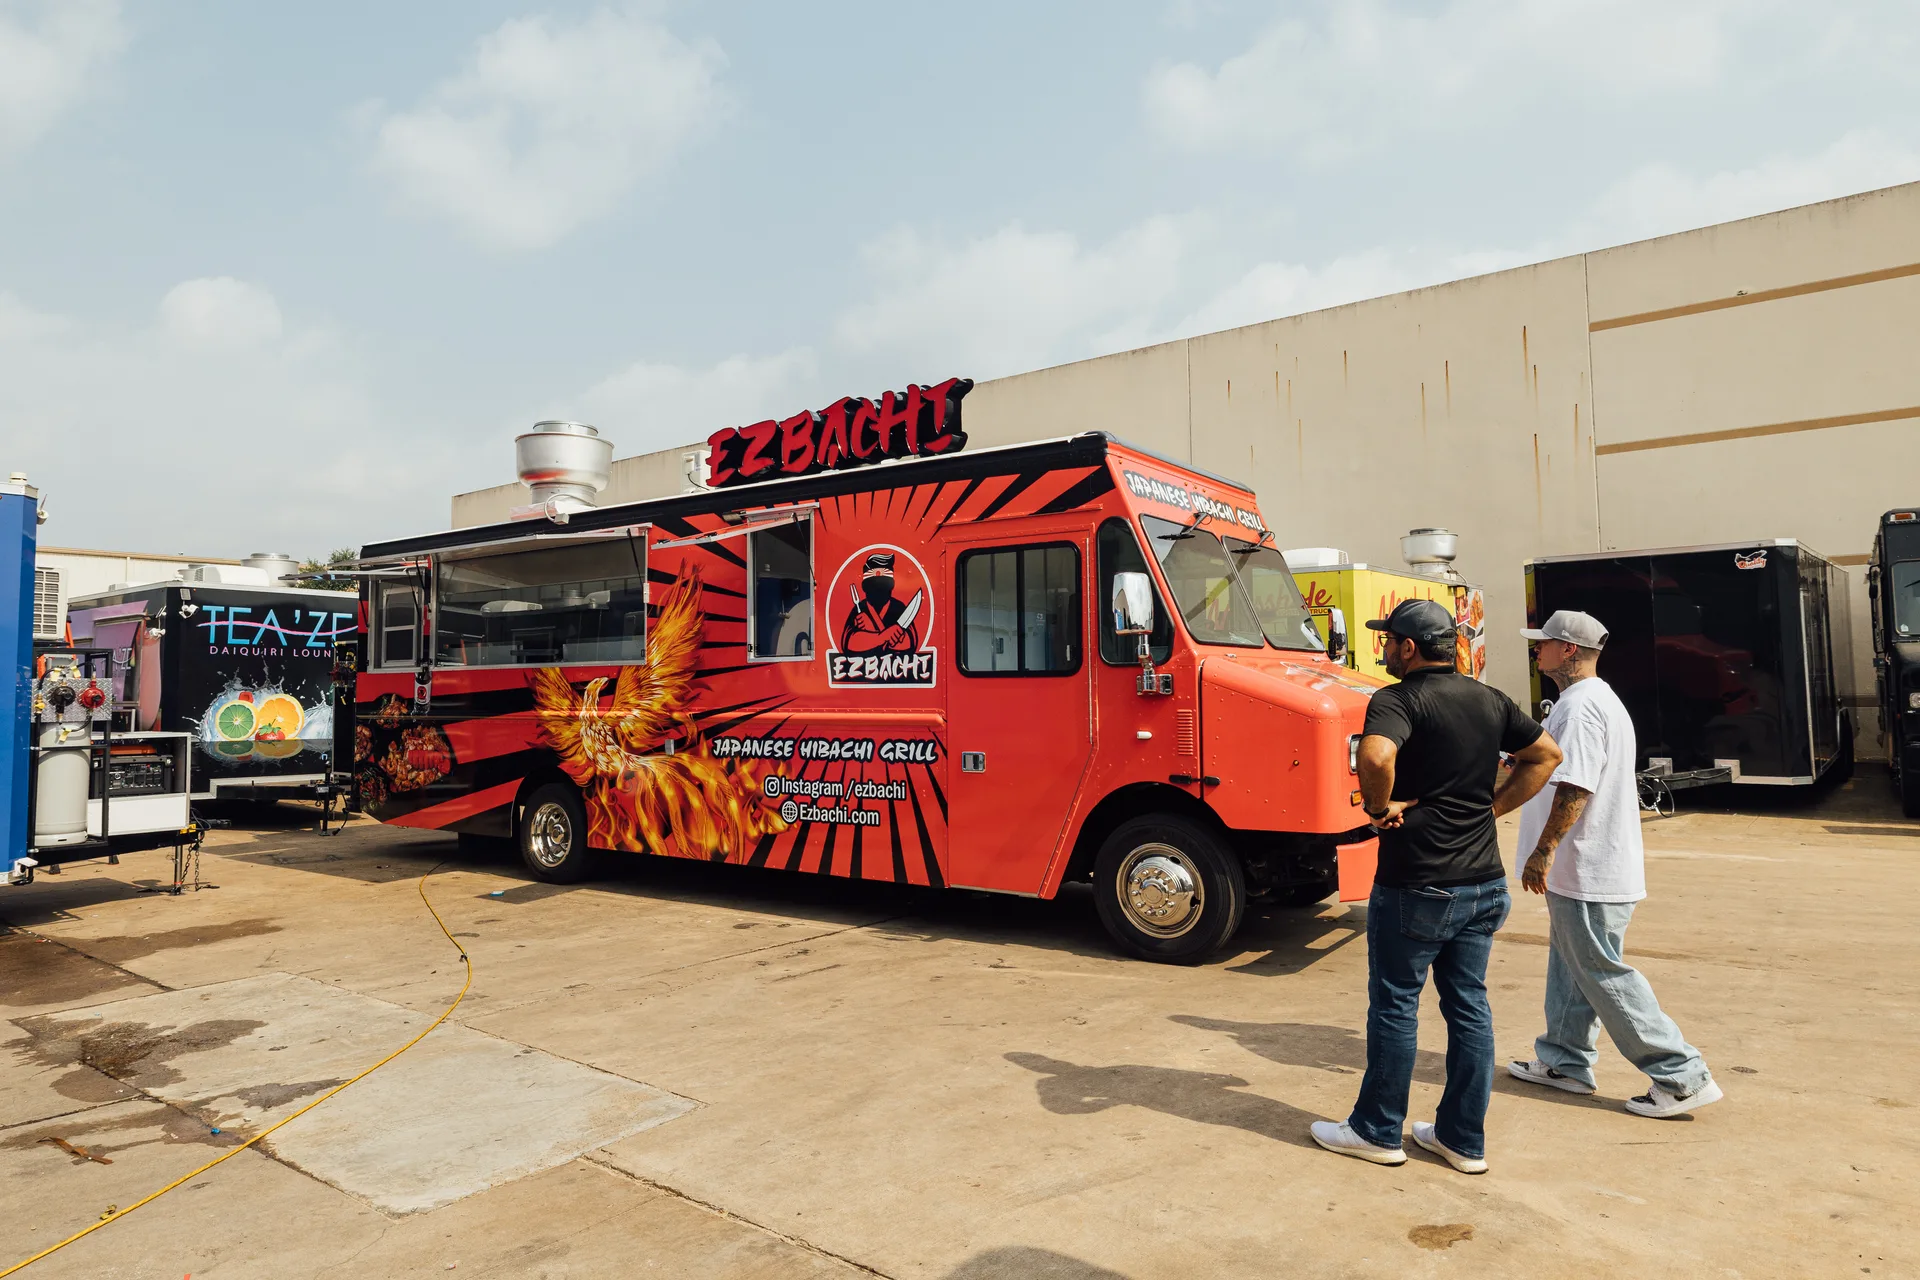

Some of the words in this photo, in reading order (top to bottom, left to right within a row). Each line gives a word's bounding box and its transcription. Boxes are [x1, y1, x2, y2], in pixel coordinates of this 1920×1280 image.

[706, 378, 960, 487] EZBACHI
[1125, 473, 1191, 509] JAPANESE
[1191, 494, 1236, 523] HIBACHI
[1237, 509, 1266, 532] GRILL
[209, 646, 284, 657] DAIQUIRI
[293, 649, 332, 658] LOUN
[833, 654, 932, 681] EZBACHI
[713, 739, 794, 758] JAPANESE
[800, 741, 874, 760] HIBACHI
[881, 742, 937, 762] GRILL
[781, 778, 843, 799] Instagram
[846, 780, 906, 800] /ezbachi
[800, 804, 880, 826] Ezbachi.com
